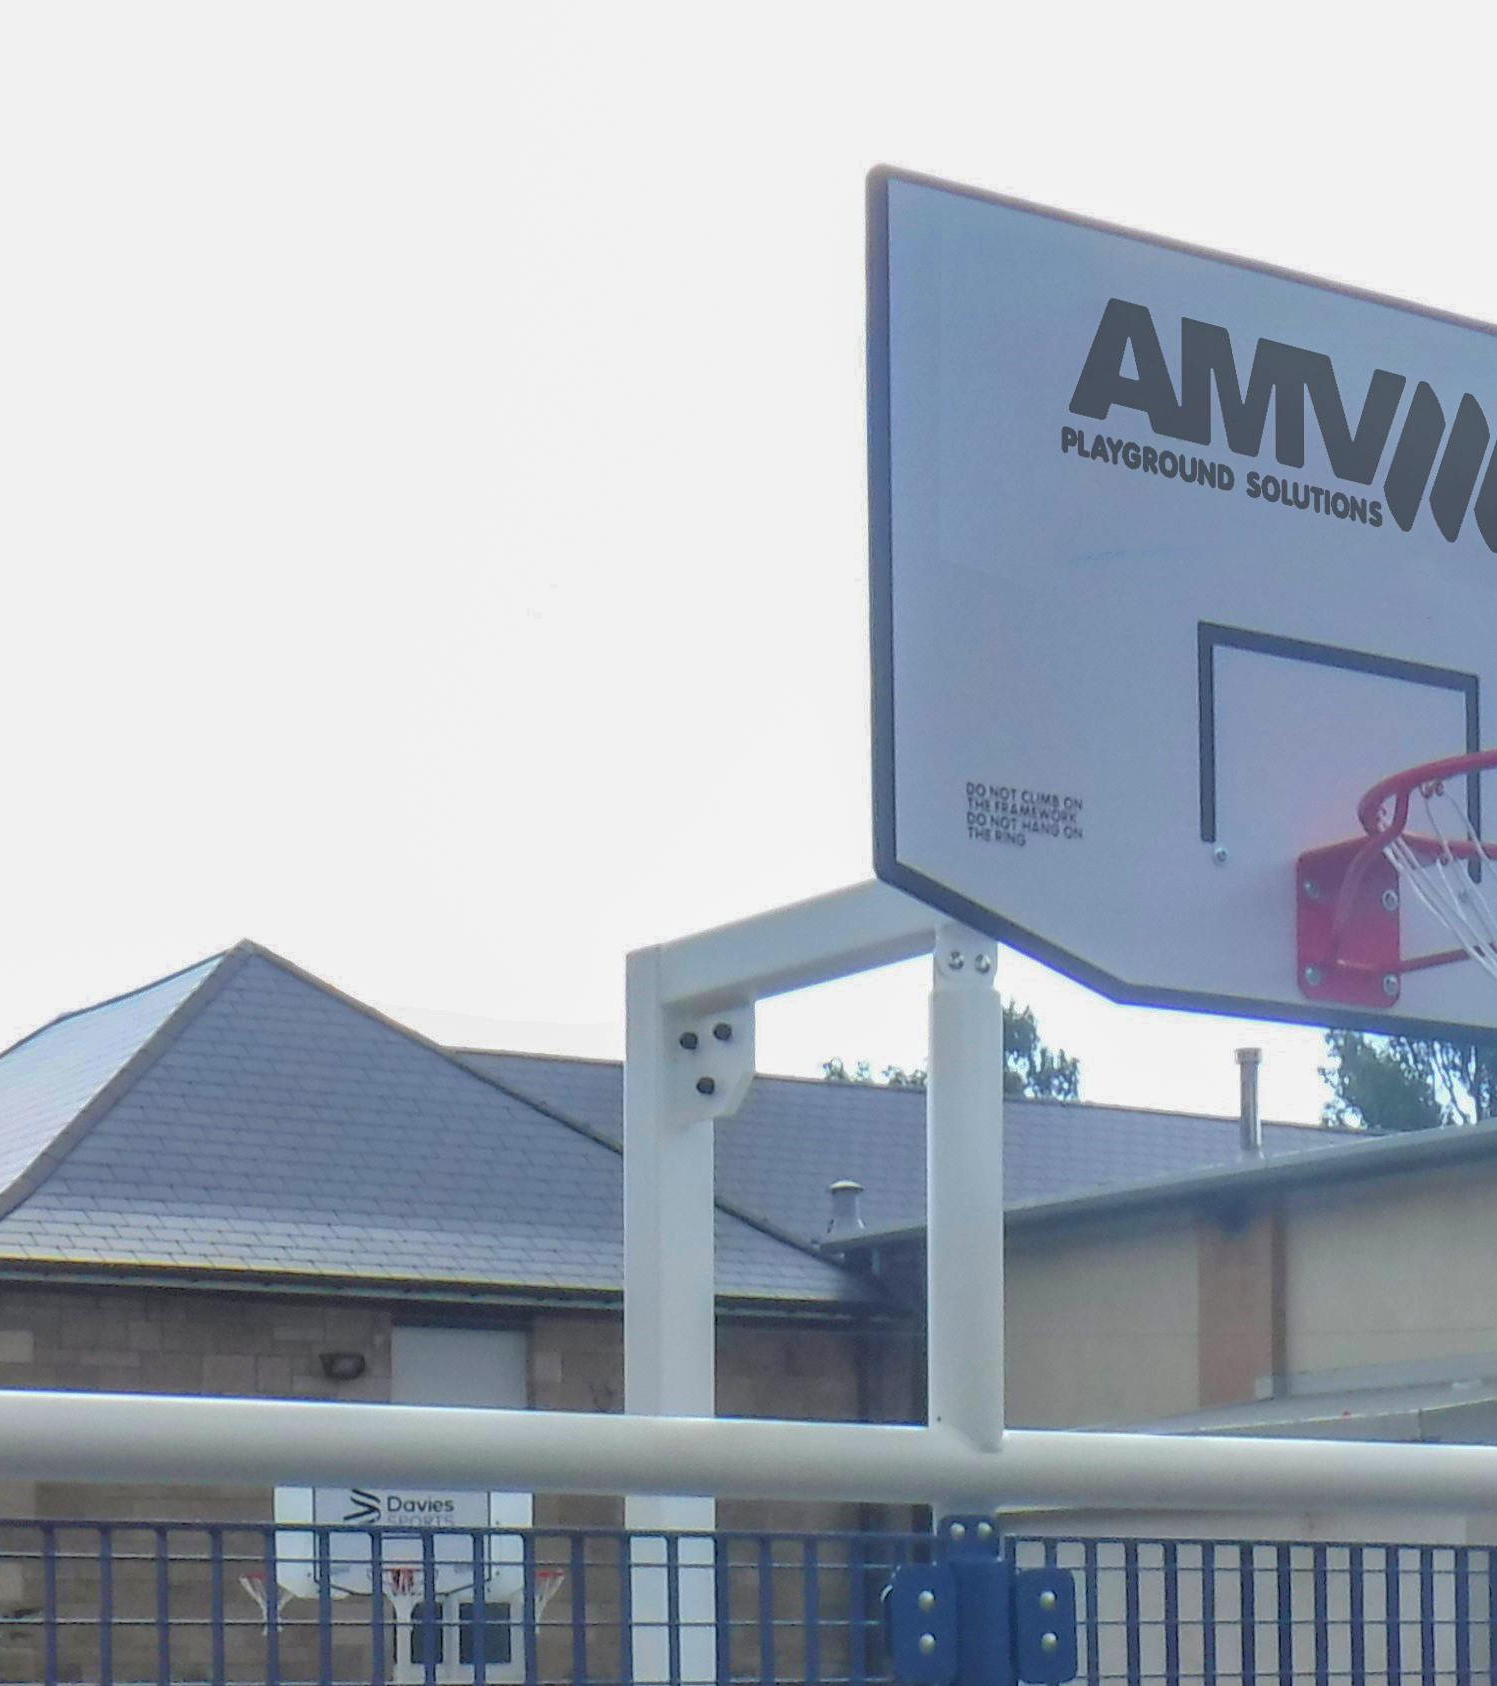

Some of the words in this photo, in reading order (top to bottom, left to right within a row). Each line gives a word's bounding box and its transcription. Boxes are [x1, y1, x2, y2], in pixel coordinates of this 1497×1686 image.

[1061, 426, 1234, 491] PLAYGROUND
[1246, 471, 1383, 527] SOLUTIONS
[966, 782, 986, 797] DO
[989, 785, 1017, 800] NOT
[1021, 790, 1060, 808] CLIMB
[1063, 797, 1083, 811] ON
[967, 797, 990, 813] THE
[995, 801, 1077, 824] FRAMEWORK
[966, 812, 987, 827] DO
[989, 815, 1017, 830] NOT
[1022, 820, 1060, 838] HANG
[1063, 826, 1083, 840] ON
[968, 826, 990, 842] THE
[995, 830, 1026, 847] RING
[387, 1495, 455, 1512] Davies
